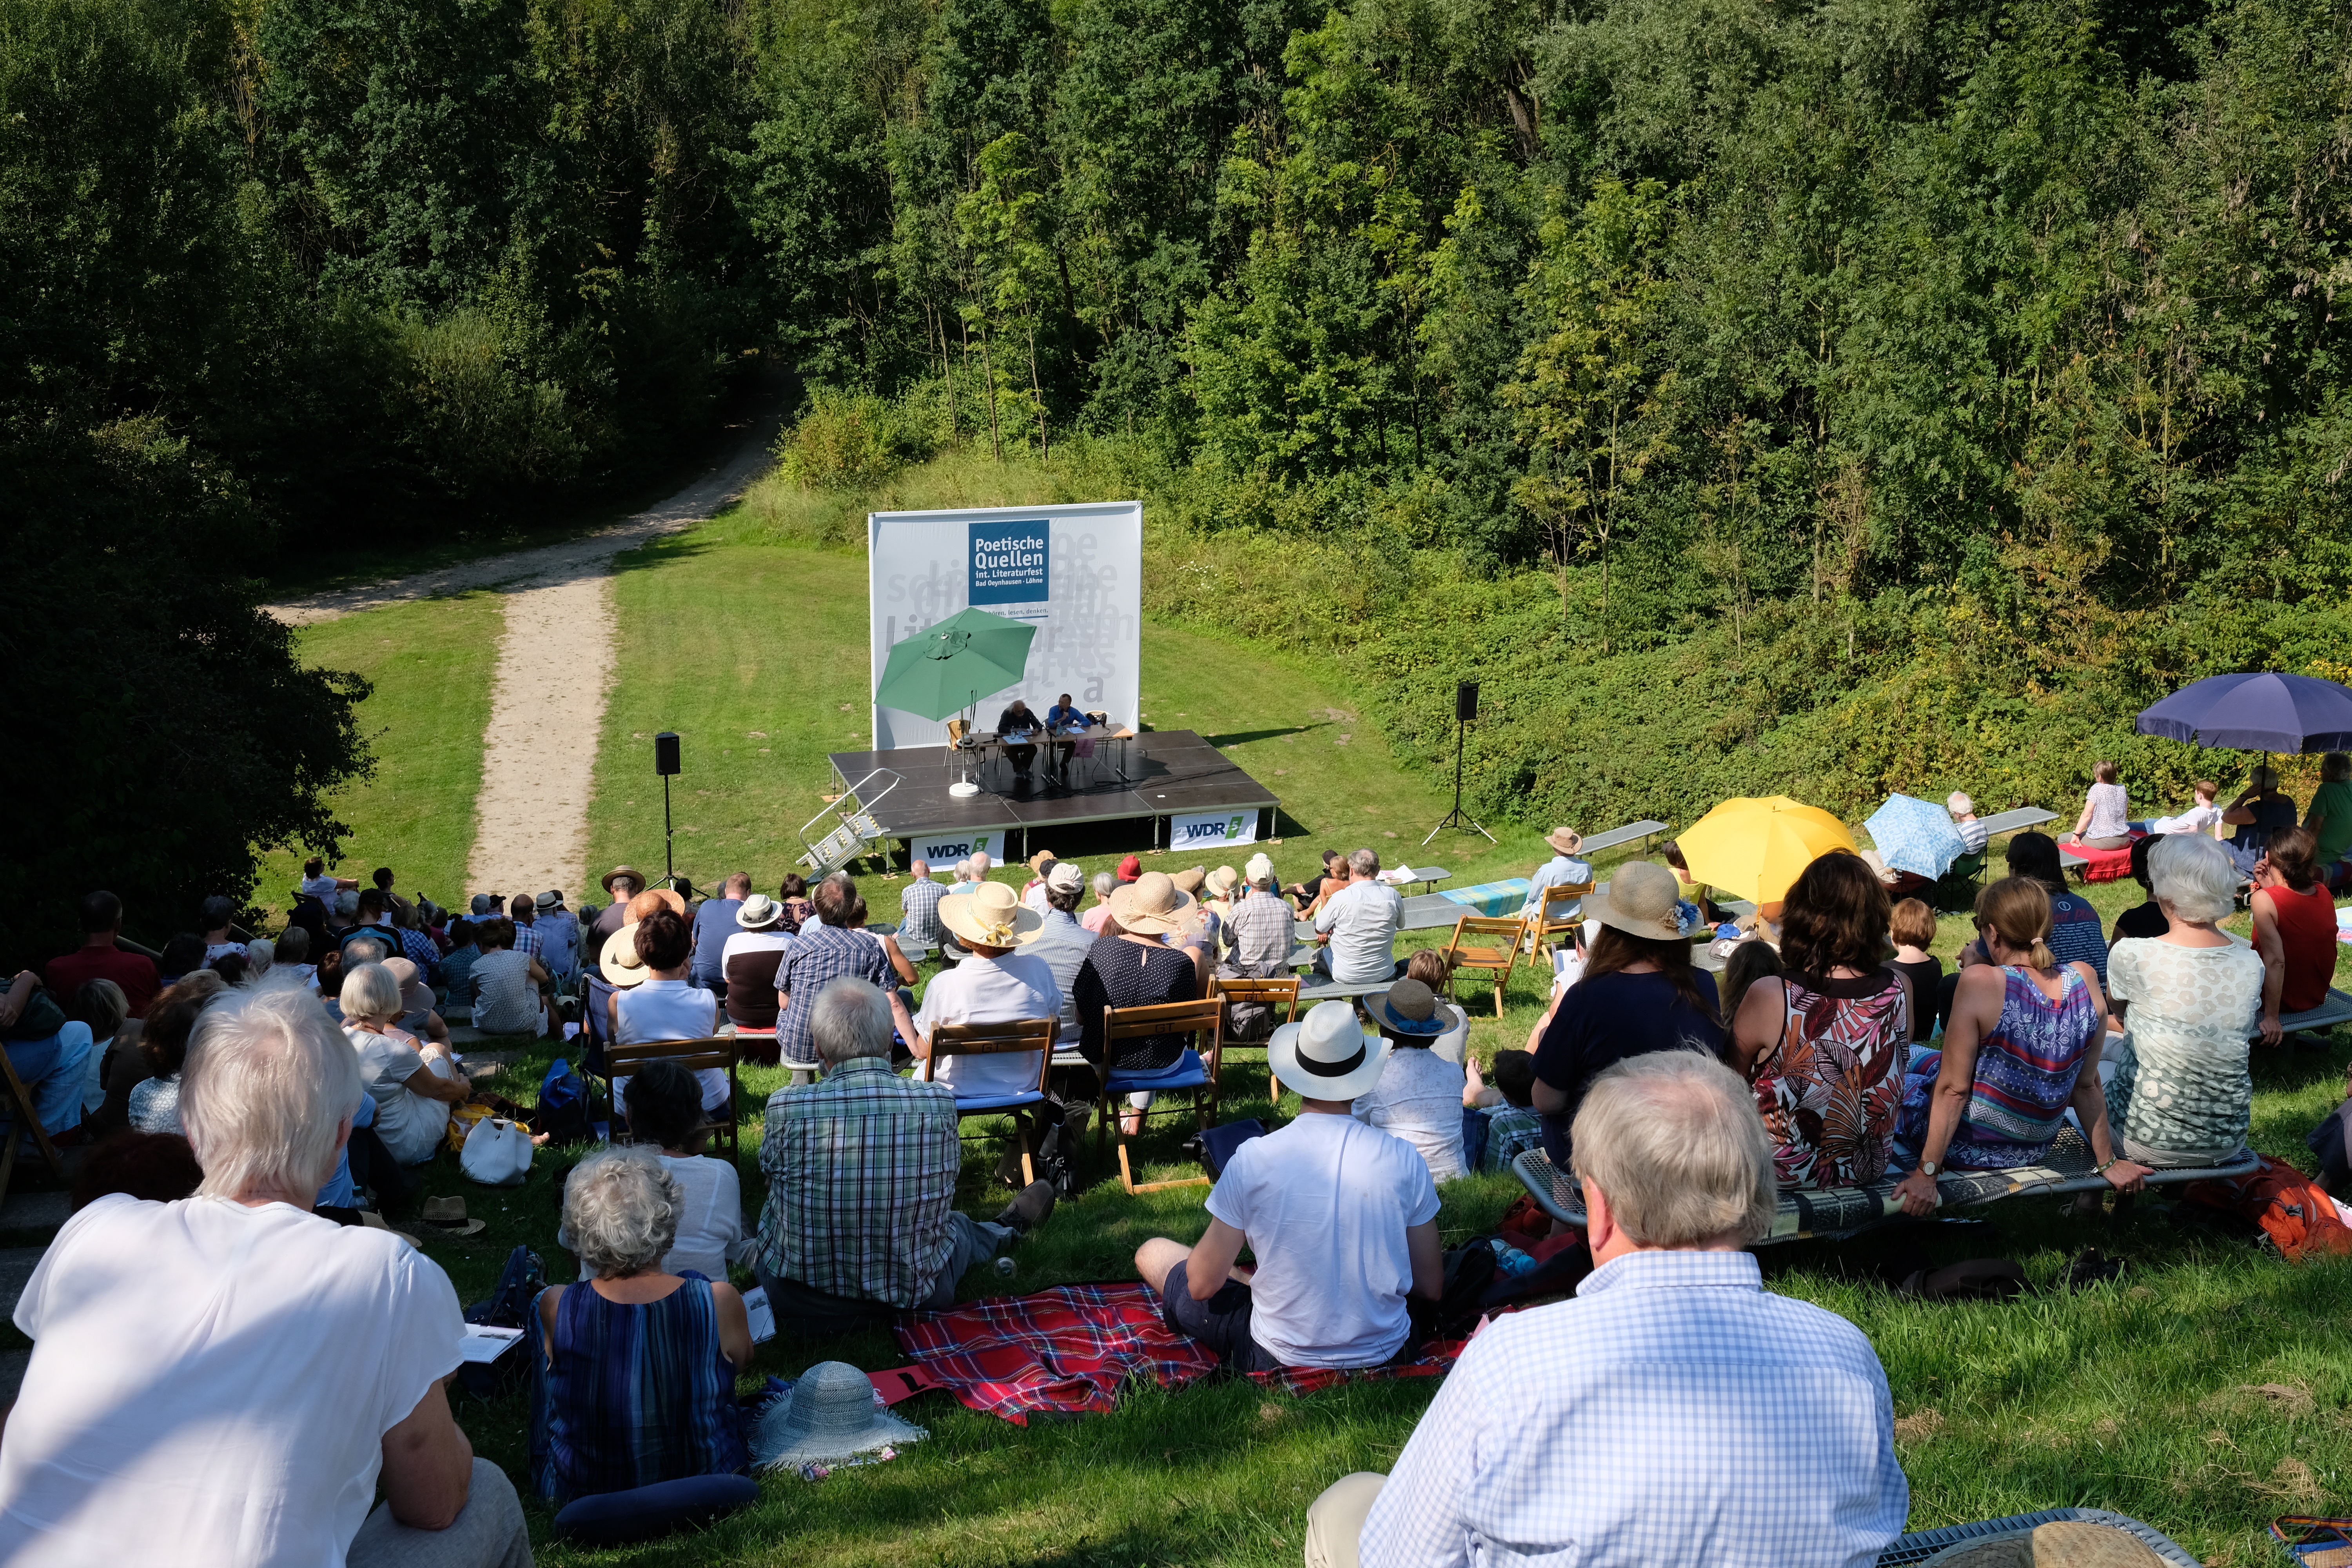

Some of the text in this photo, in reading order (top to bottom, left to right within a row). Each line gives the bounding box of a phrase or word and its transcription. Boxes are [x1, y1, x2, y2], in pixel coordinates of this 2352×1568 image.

[976, 535, 1044, 552] Poetische
[975, 550, 1043, 570] Quellen
[975, 568, 1043, 579] int. Literaturfest
[988, 579, 1022, 587] Oeynhausen
[1186, 821, 1238, 838] WDR 5
[927, 842, 983, 858] WDR 5
[1155, 1022, 1175, 1033] GT
[982, 1043, 1002, 1053] GT
